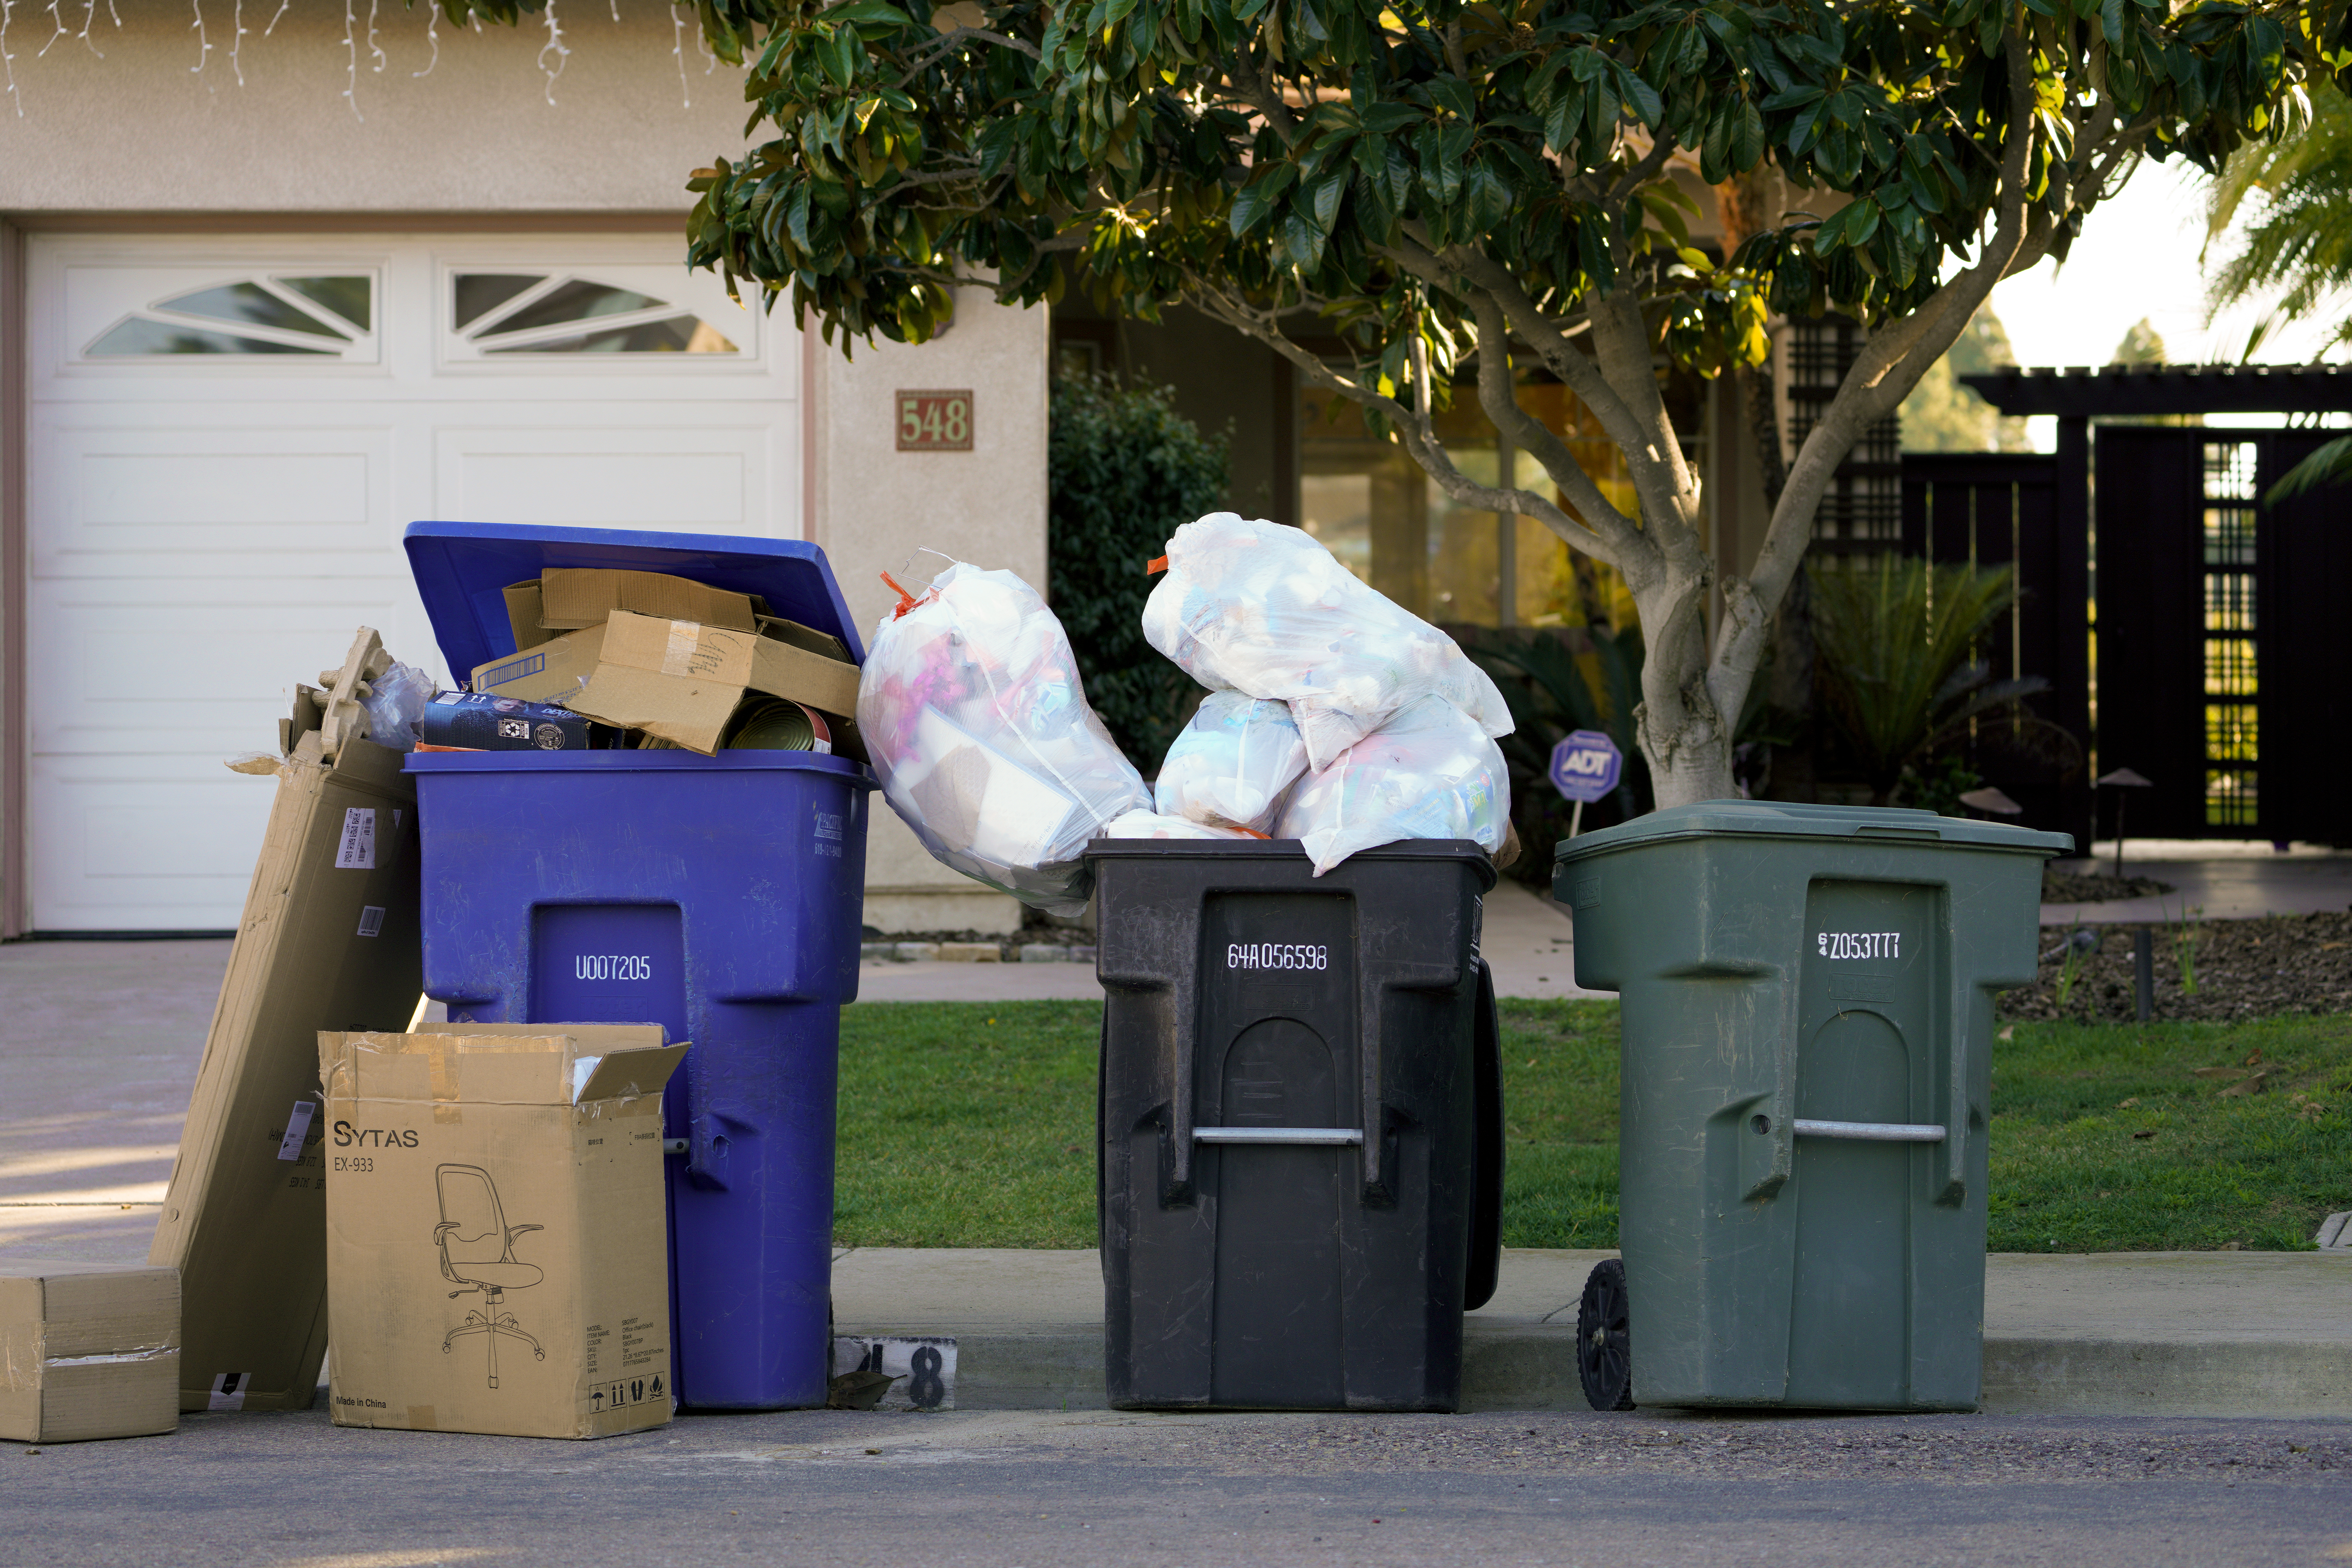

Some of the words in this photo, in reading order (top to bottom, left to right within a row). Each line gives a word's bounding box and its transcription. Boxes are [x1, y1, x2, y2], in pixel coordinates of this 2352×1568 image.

[902, 400, 967, 441] 548
[1562, 750, 1611, 776] ADT
[821, 813, 842, 830] PACIFIC
[1227, 943, 1327, 970] 64A056598
[576, 955, 650, 980] U007205
[334, 1120, 419, 1148] SYTAS
[335, 1157, 373, 1172] EX-933
[633, 1322, 653, 1331] chair(black)
[623, 1338, 643, 1347] SBGY007BP
[336, 1396, 355, 1406] Made
[357, 1398, 363, 1406] in
[365, 1399, 386, 1408] China
